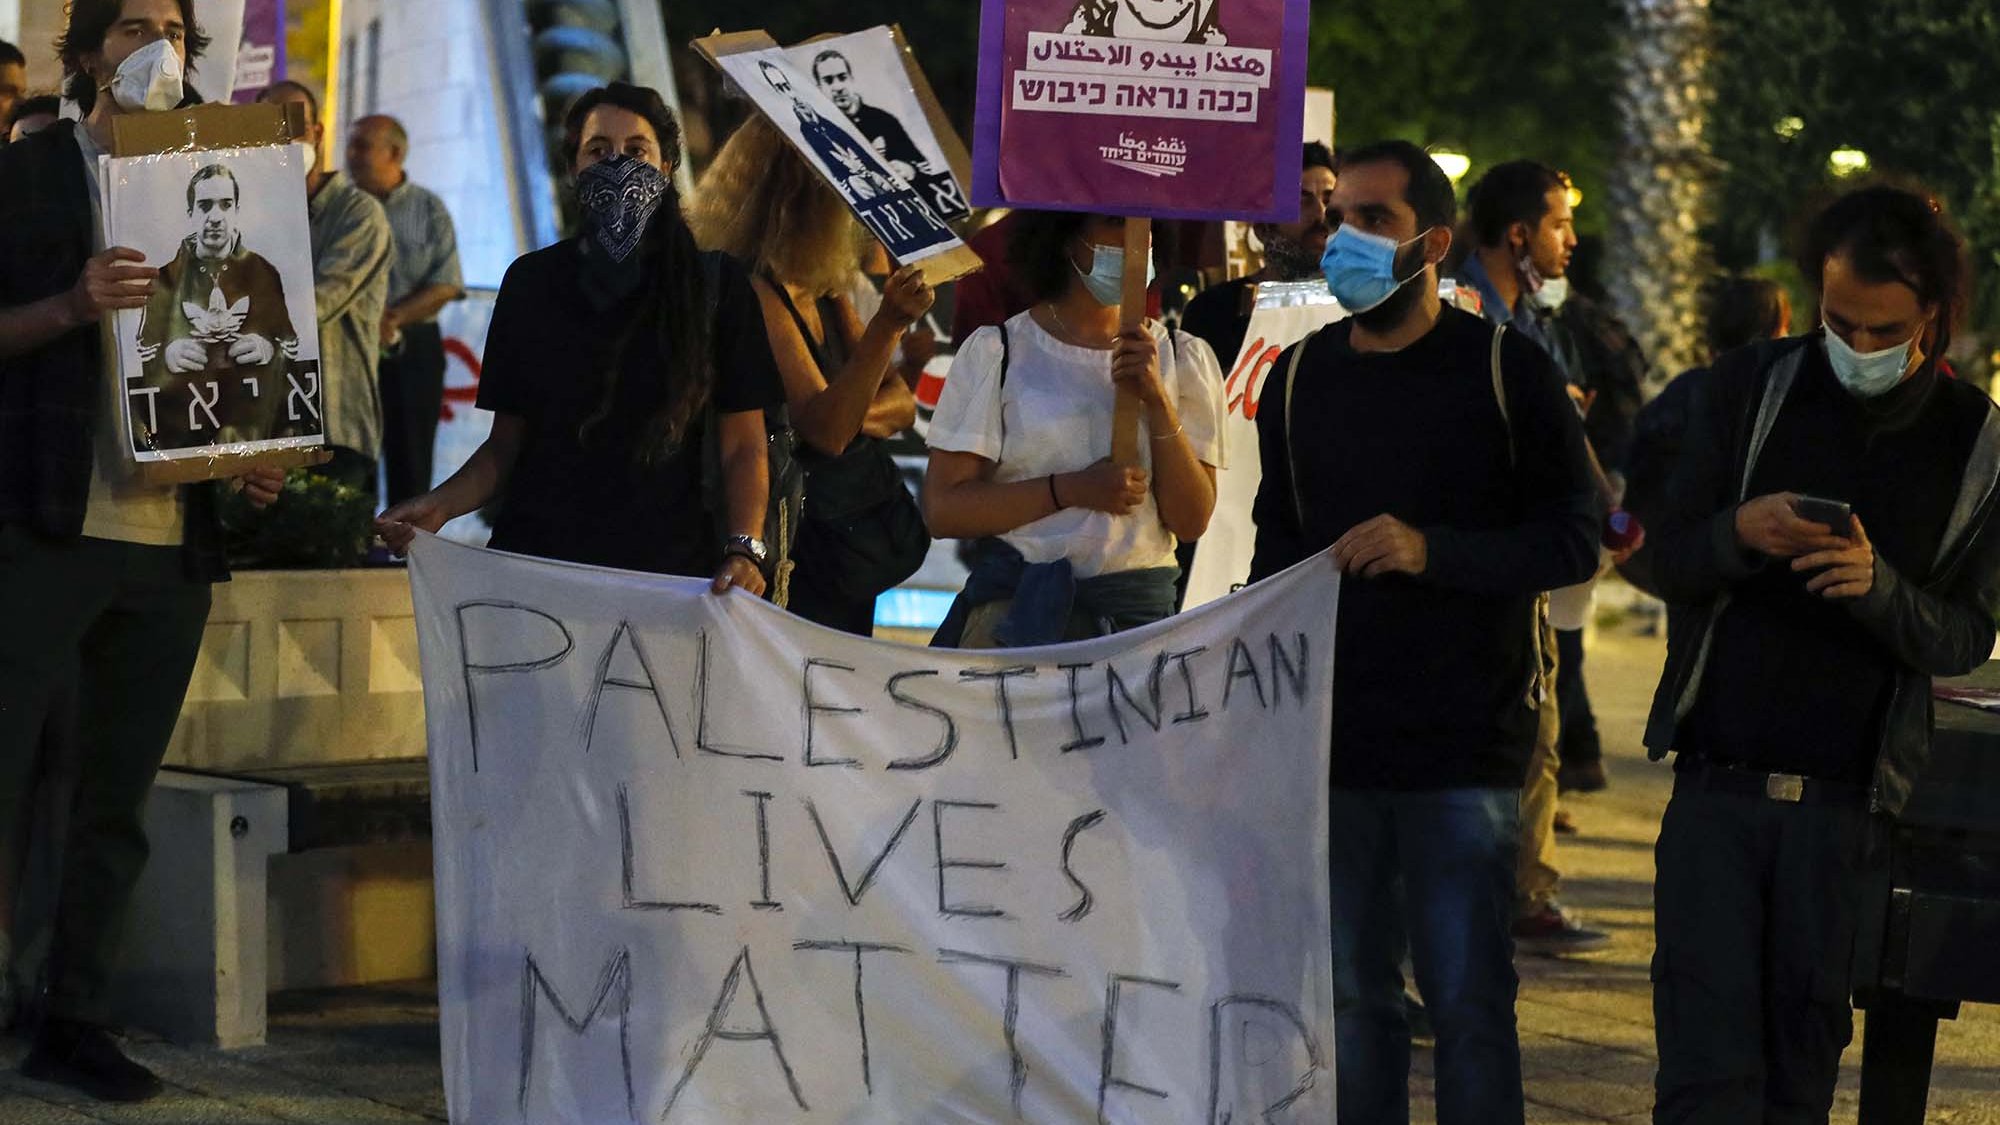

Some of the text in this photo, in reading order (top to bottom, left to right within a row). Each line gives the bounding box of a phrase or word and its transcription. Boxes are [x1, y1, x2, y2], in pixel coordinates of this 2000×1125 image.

[1018, 78, 1253, 113] ככה נראה כיבוש
[1033, 40, 1265, 77] هكذا يبدو الاحتلال
[1098, 146, 1187, 167] עומדים ביחד
[456, 602, 1310, 774] PALESTINIAN
[615, 781, 1109, 924] LIVES
[518, 937, 1329, 1125] MATTER
